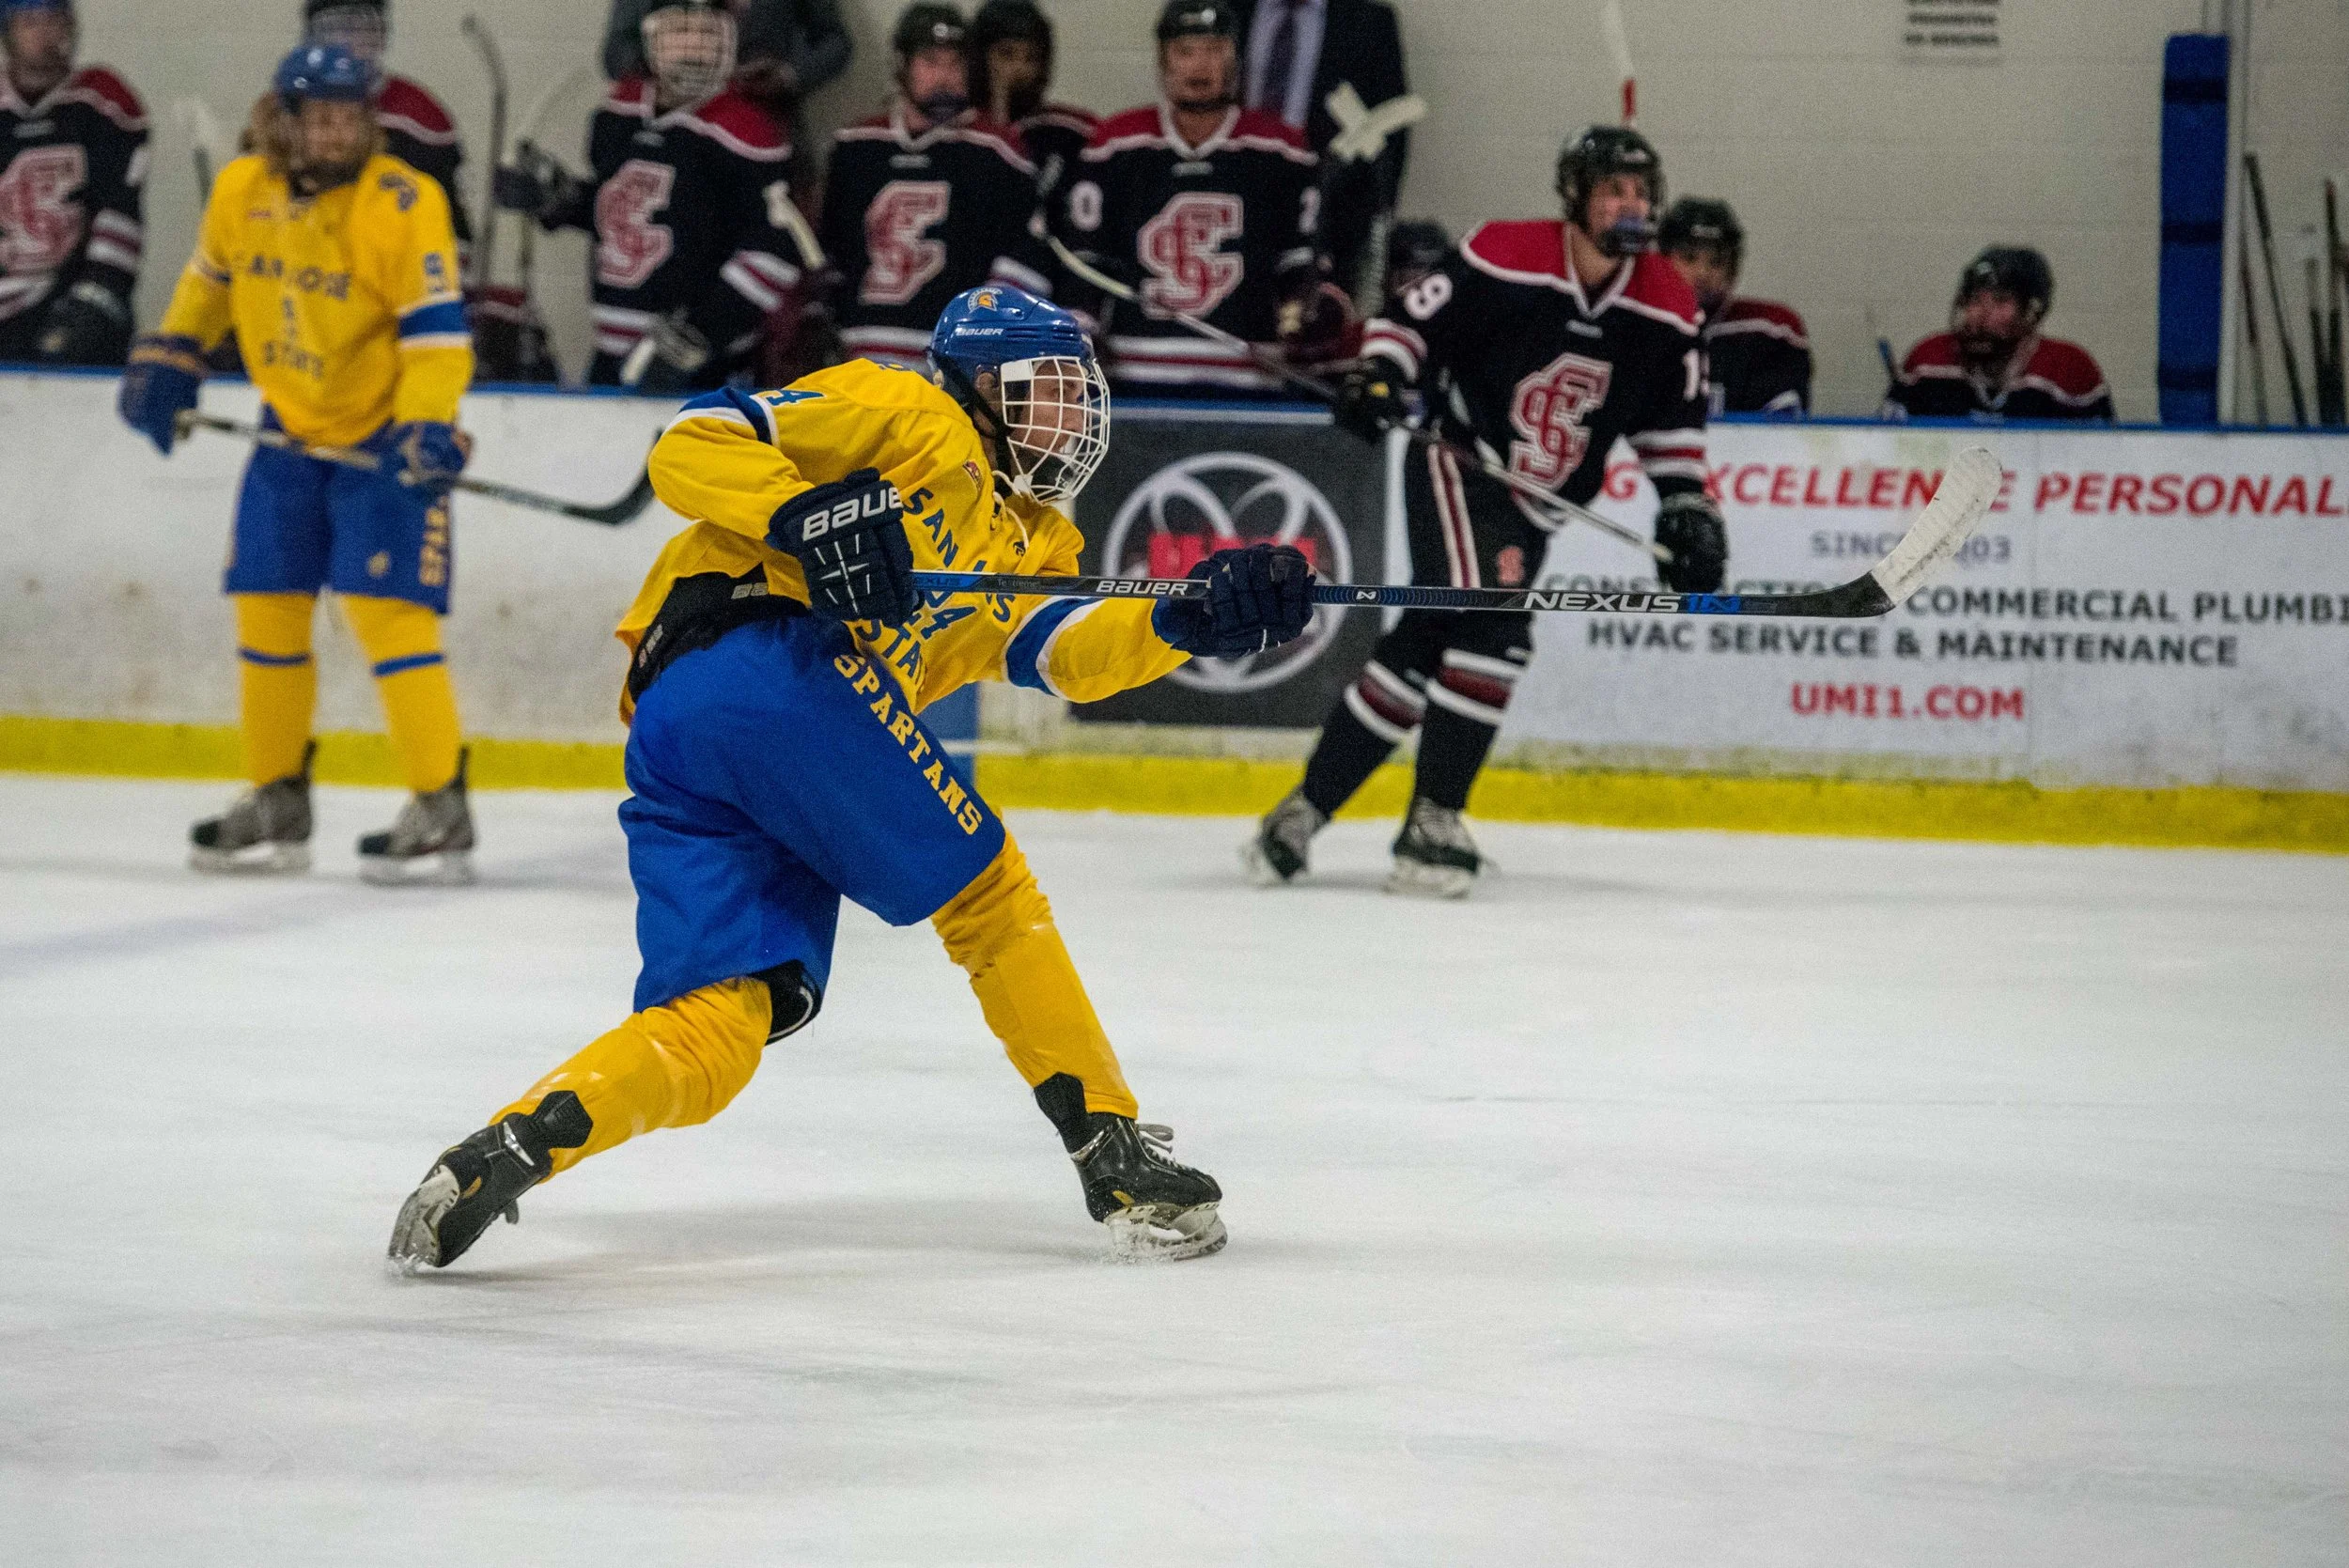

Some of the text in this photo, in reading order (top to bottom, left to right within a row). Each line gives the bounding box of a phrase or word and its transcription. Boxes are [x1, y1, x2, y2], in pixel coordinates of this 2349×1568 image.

[1523, 591, 1682, 613] NEXUS
[1588, 619, 1696, 652] HVAC
[1708, 621, 1879, 658] SERVICE
[1937, 629, 2240, 669] MAINTENANCE
[833, 654, 984, 835] SPARTANS
